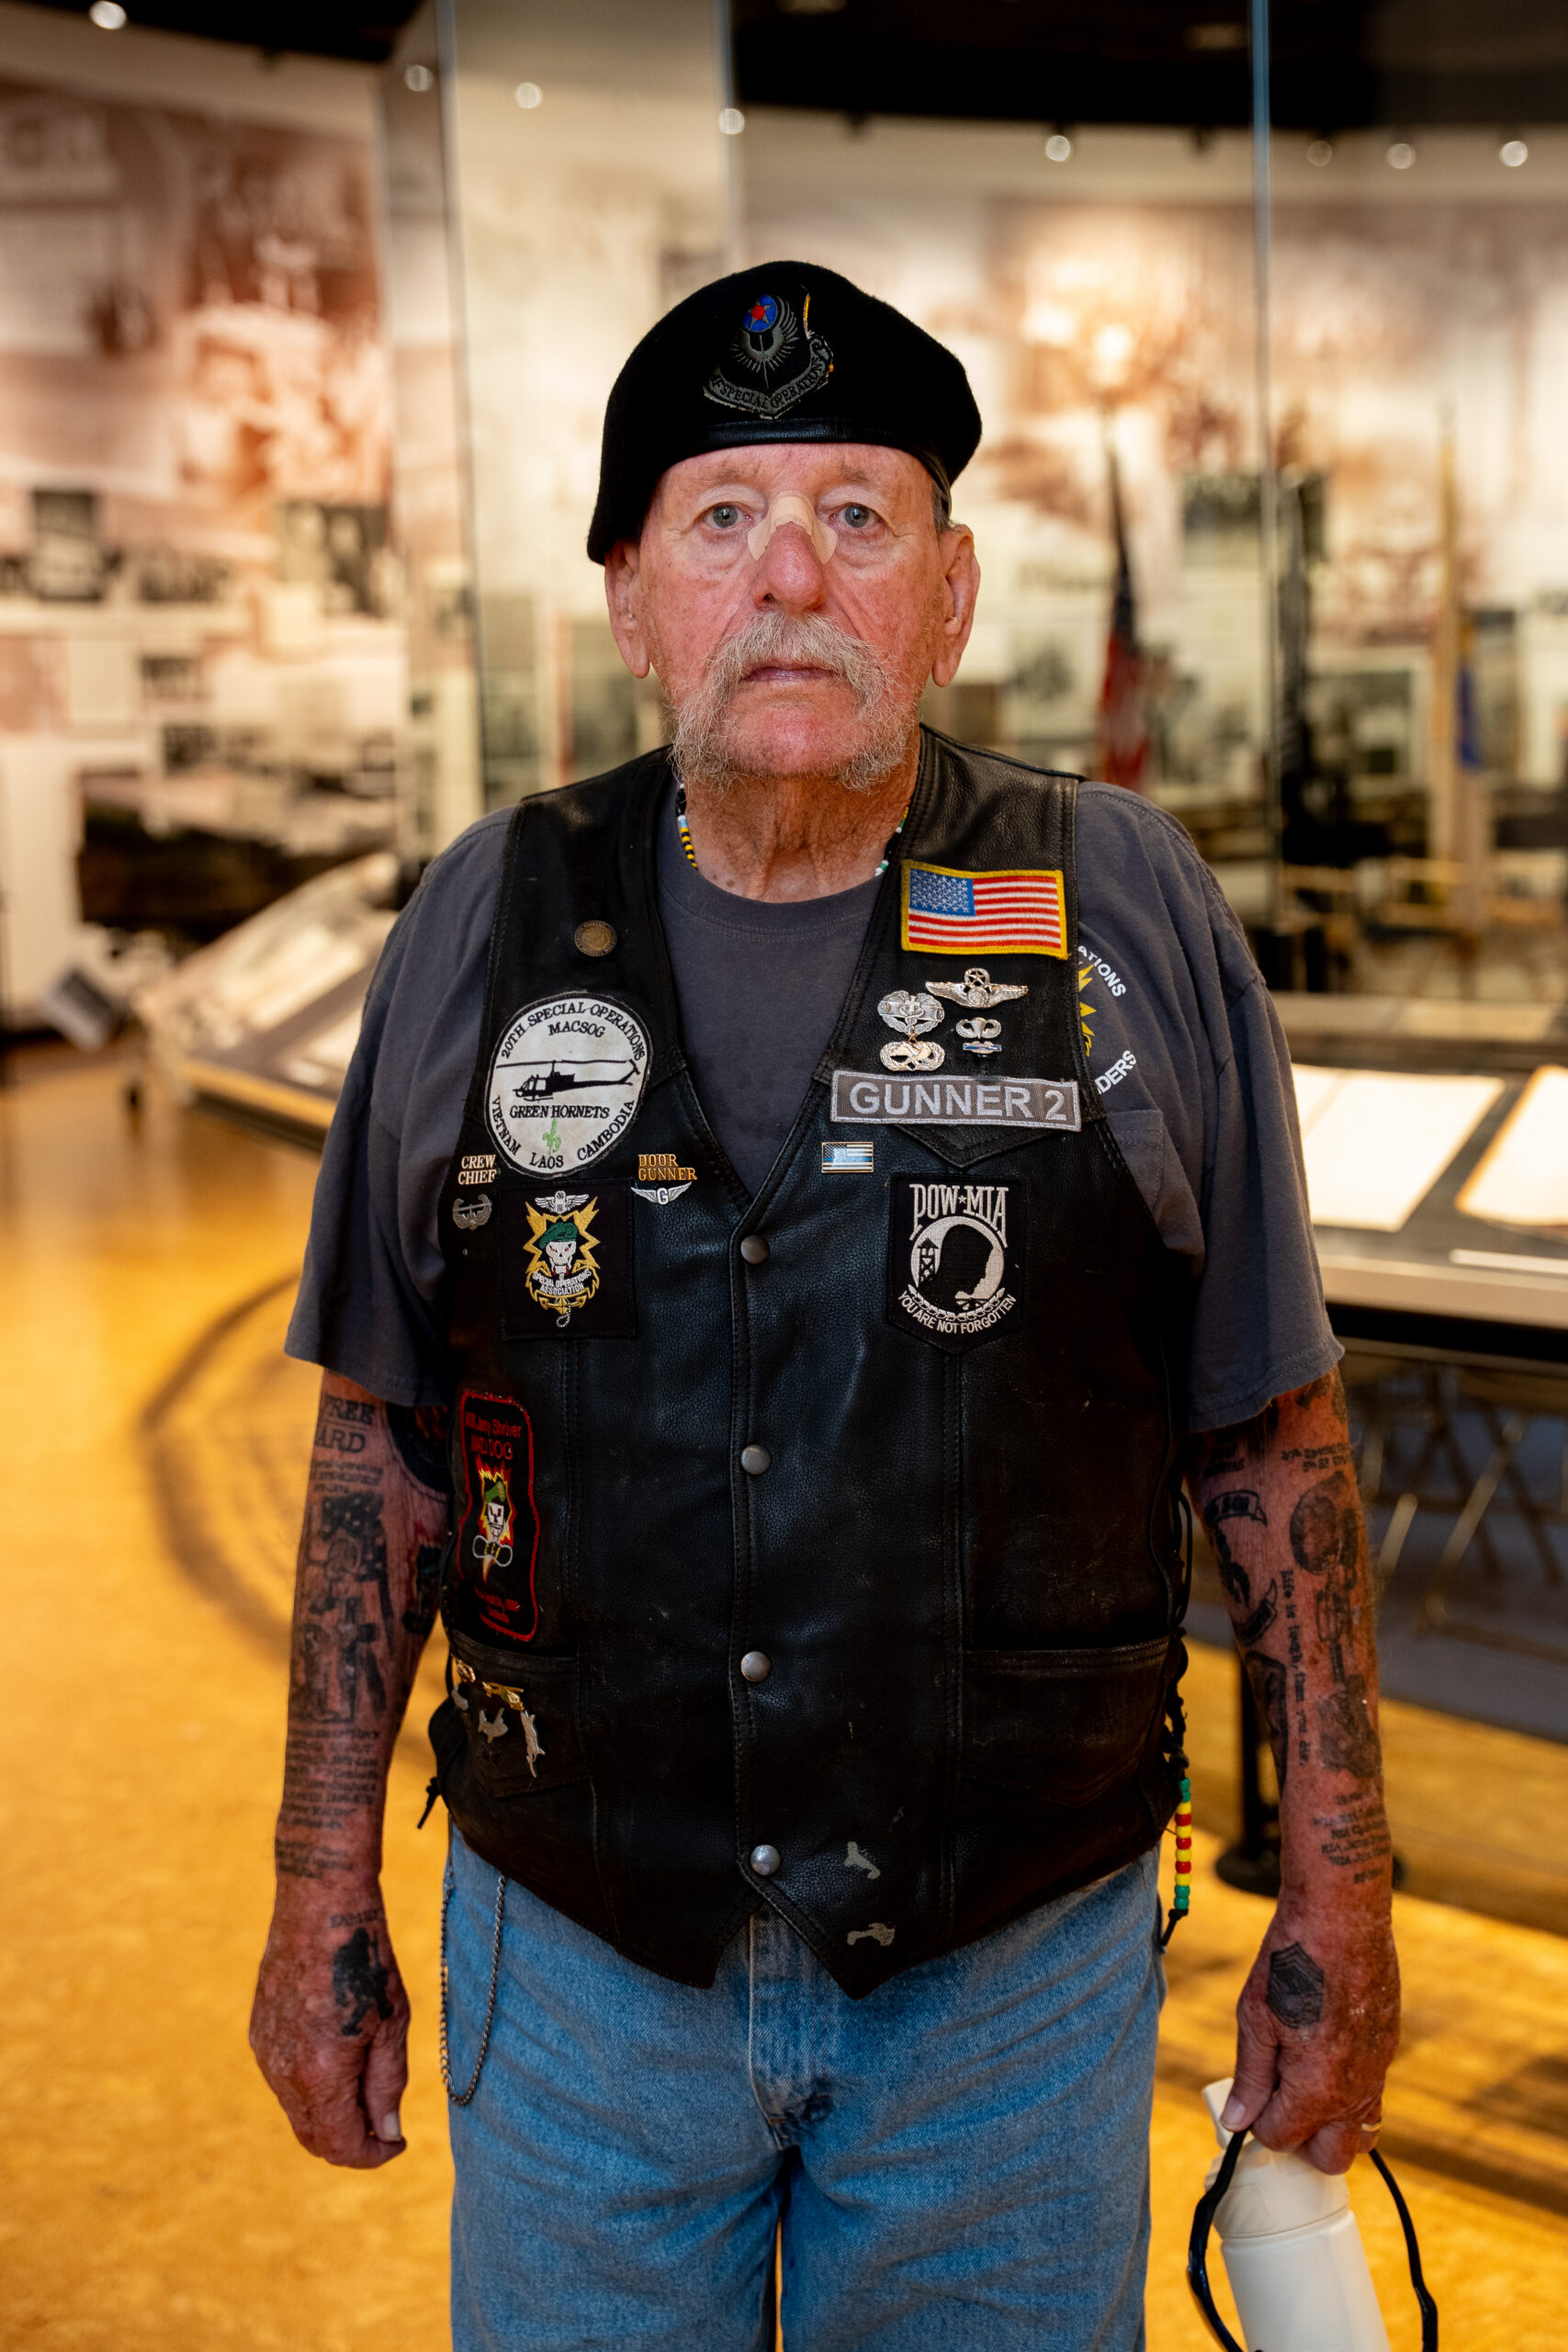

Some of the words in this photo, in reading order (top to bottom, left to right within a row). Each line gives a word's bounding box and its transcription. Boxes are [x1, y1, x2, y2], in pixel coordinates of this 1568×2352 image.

[720, 383, 770, 409] SPECIAL
[501, 1023, 525, 1058] 20TH
[527, 1001, 587, 1027] SPECIAL
[590, 1003, 646, 1062] OPERATIONS
[547, 1020, 606, 1038] MACSOG
[849, 1081, 1033, 1118] GUNNER
[1044, 1090, 1067, 1121] 2
[509, 1105, 549, 1118] GREEN
[550, 1105, 610, 1119] HORNETS
[491, 1094, 522, 1156] VIETNAM
[577, 1100, 635, 1161] CAMBODIA
[461, 1154, 496, 1170] CREW
[529, 1152, 564, 1168] LAOS
[637, 1153, 679, 1167] DOOR
[457, 1169, 497, 1185] CHIEF
[637, 1167, 698, 1181] GUNNER
[657, 1187, 669, 1204] G
[532, 1271, 555, 1287] SPECIAL
[555, 1268, 592, 1288] OPERATIONS
[539, 1283, 584, 1295] ASSOCIATION
[897, 1290, 917, 1314] YOU
[912, 1306, 938, 1329] ARE
[936, 1319, 958, 1334] NOT
[961, 1294, 1017, 1334] FORGOTTEN
[489, 1438, 513, 1460] DOG
